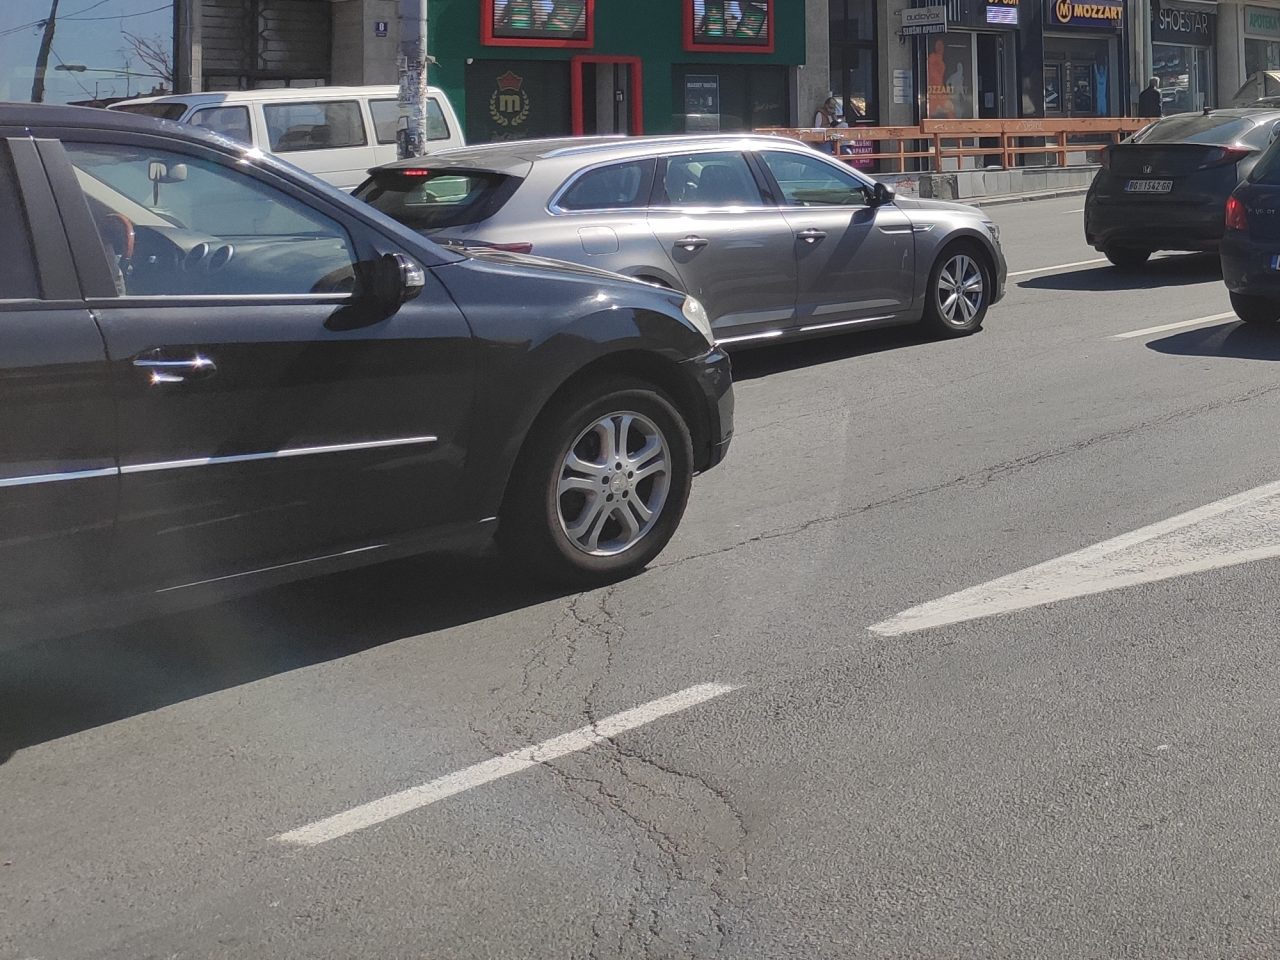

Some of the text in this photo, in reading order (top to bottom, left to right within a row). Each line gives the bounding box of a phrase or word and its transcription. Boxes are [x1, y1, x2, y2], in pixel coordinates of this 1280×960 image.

[1073, 3, 1123, 20] MOZZART
[1159, 9, 1209, 33] SHOESTAR
[1249, 13, 1279, 30] APOTEKA
